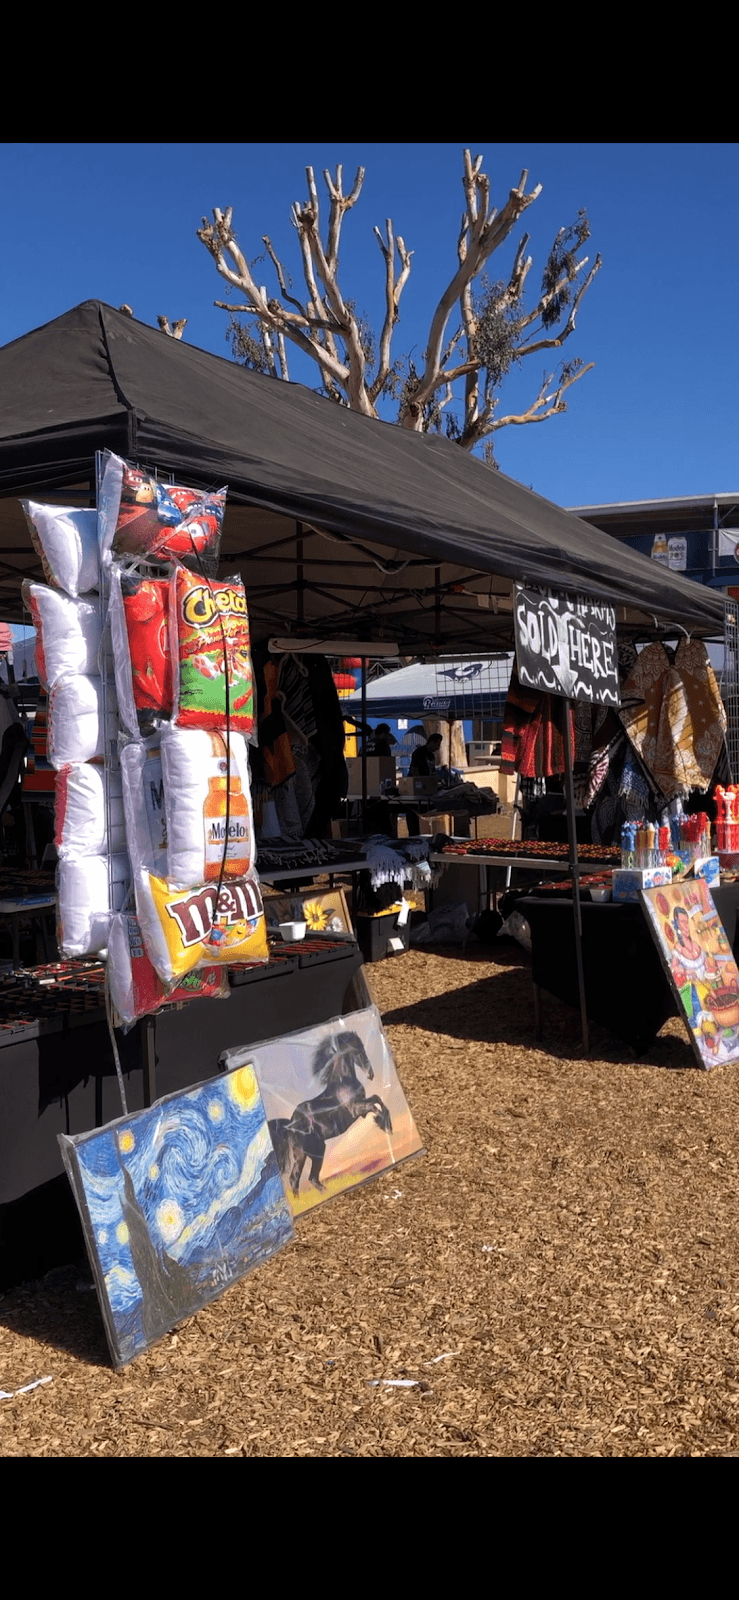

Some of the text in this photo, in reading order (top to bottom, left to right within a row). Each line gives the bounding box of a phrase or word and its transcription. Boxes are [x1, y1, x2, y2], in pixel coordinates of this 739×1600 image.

[516, 603, 618, 684] SOLD HERE
[211, 821, 245, 839] Moelo
